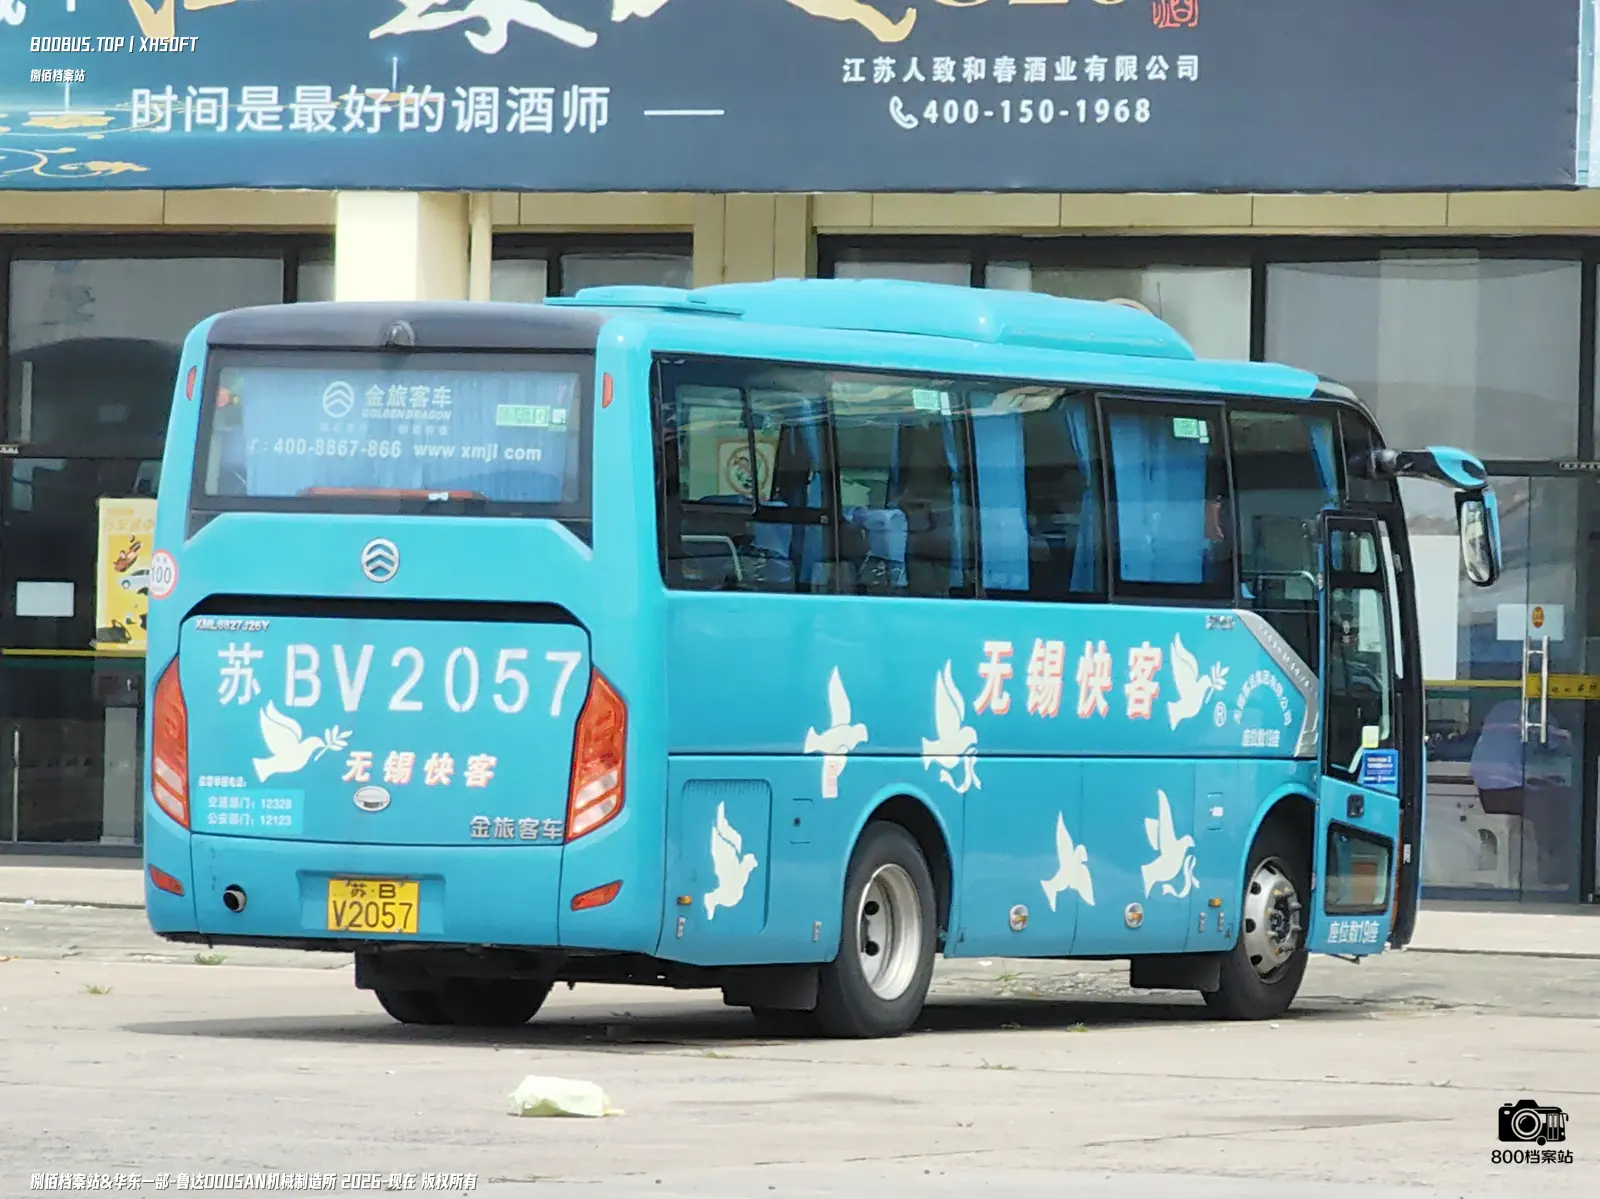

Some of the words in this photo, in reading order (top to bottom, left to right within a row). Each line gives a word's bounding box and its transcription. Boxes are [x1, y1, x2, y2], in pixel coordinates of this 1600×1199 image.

[842, 55, 1200, 83] 江苏人致和春酒业有限公司
[923, 98, 1152, 125] 400-150-1968
[364, 384, 453, 408] 金旅客车
[973, 637, 1164, 720] 无锡快客
[342, 749, 498, 789] 无锡快客
[470, 815, 563, 840] 金旅客车
[332, 899, 414, 930] V2057
